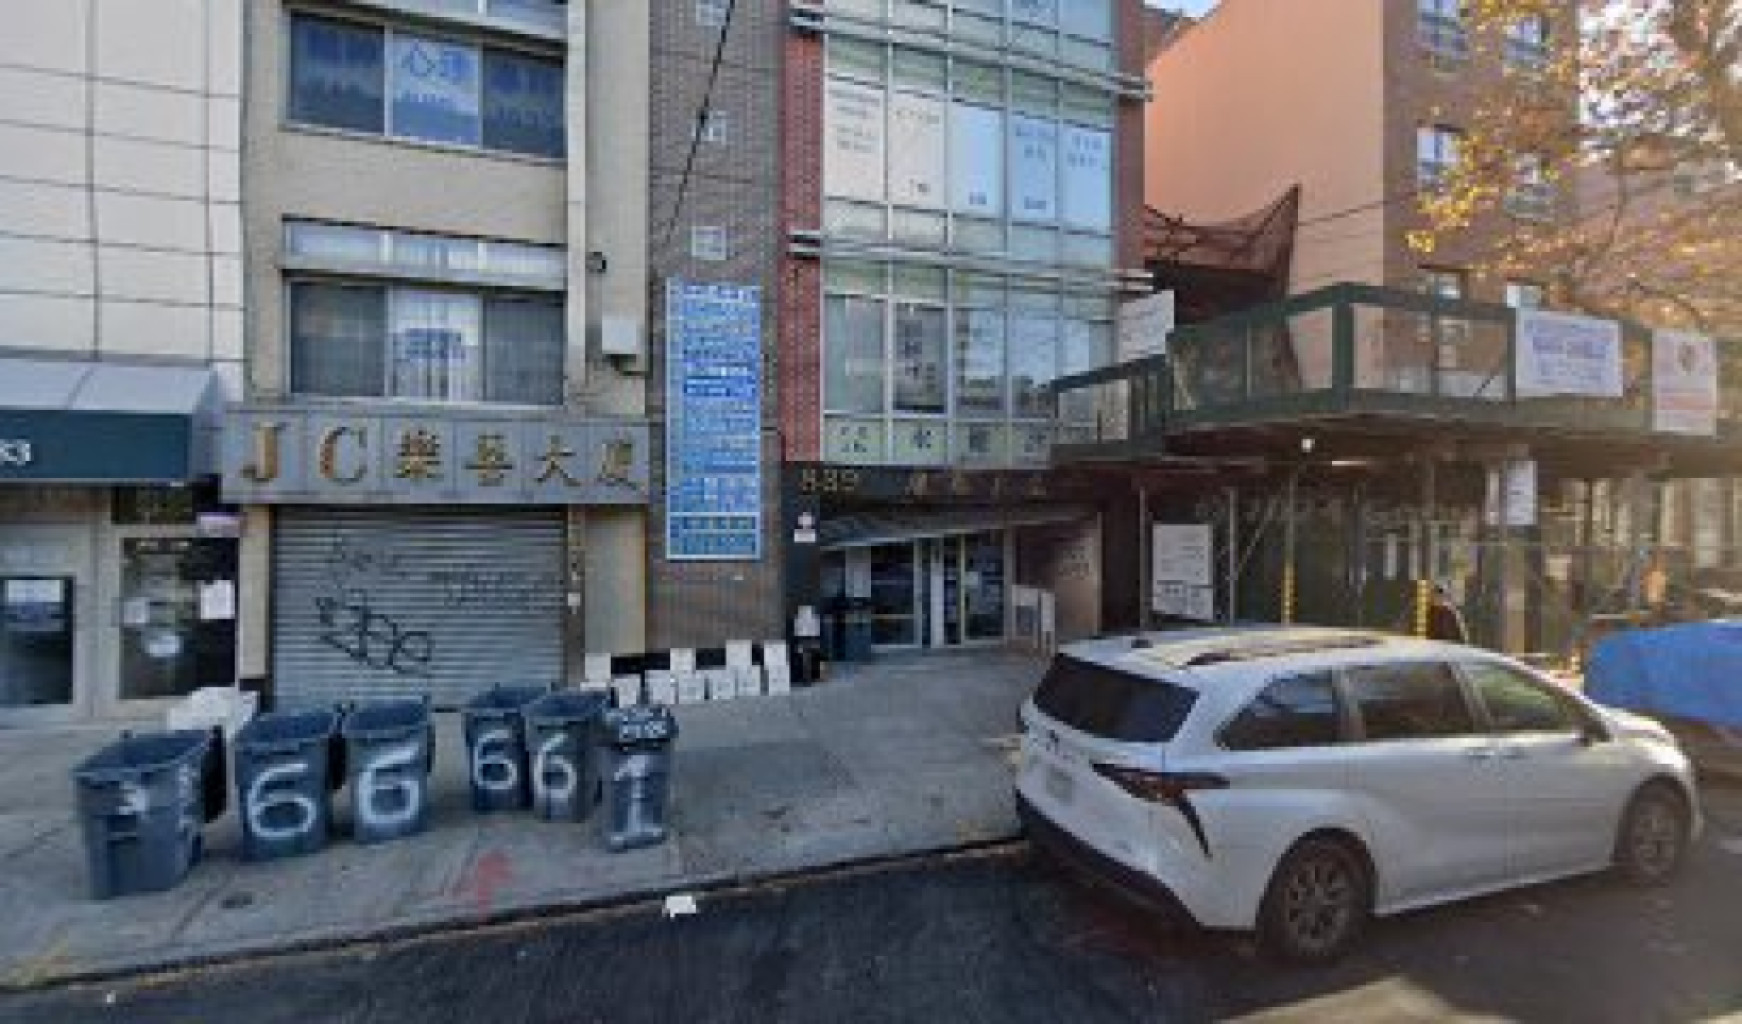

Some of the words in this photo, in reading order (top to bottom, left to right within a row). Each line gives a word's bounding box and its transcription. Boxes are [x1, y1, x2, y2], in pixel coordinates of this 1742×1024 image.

[357, 745, 420, 825] 6
[474, 729, 517, 790] 6
[533, 732, 577, 804] 6
[248, 763, 317, 838] 6
[611, 753, 664, 846] 1
